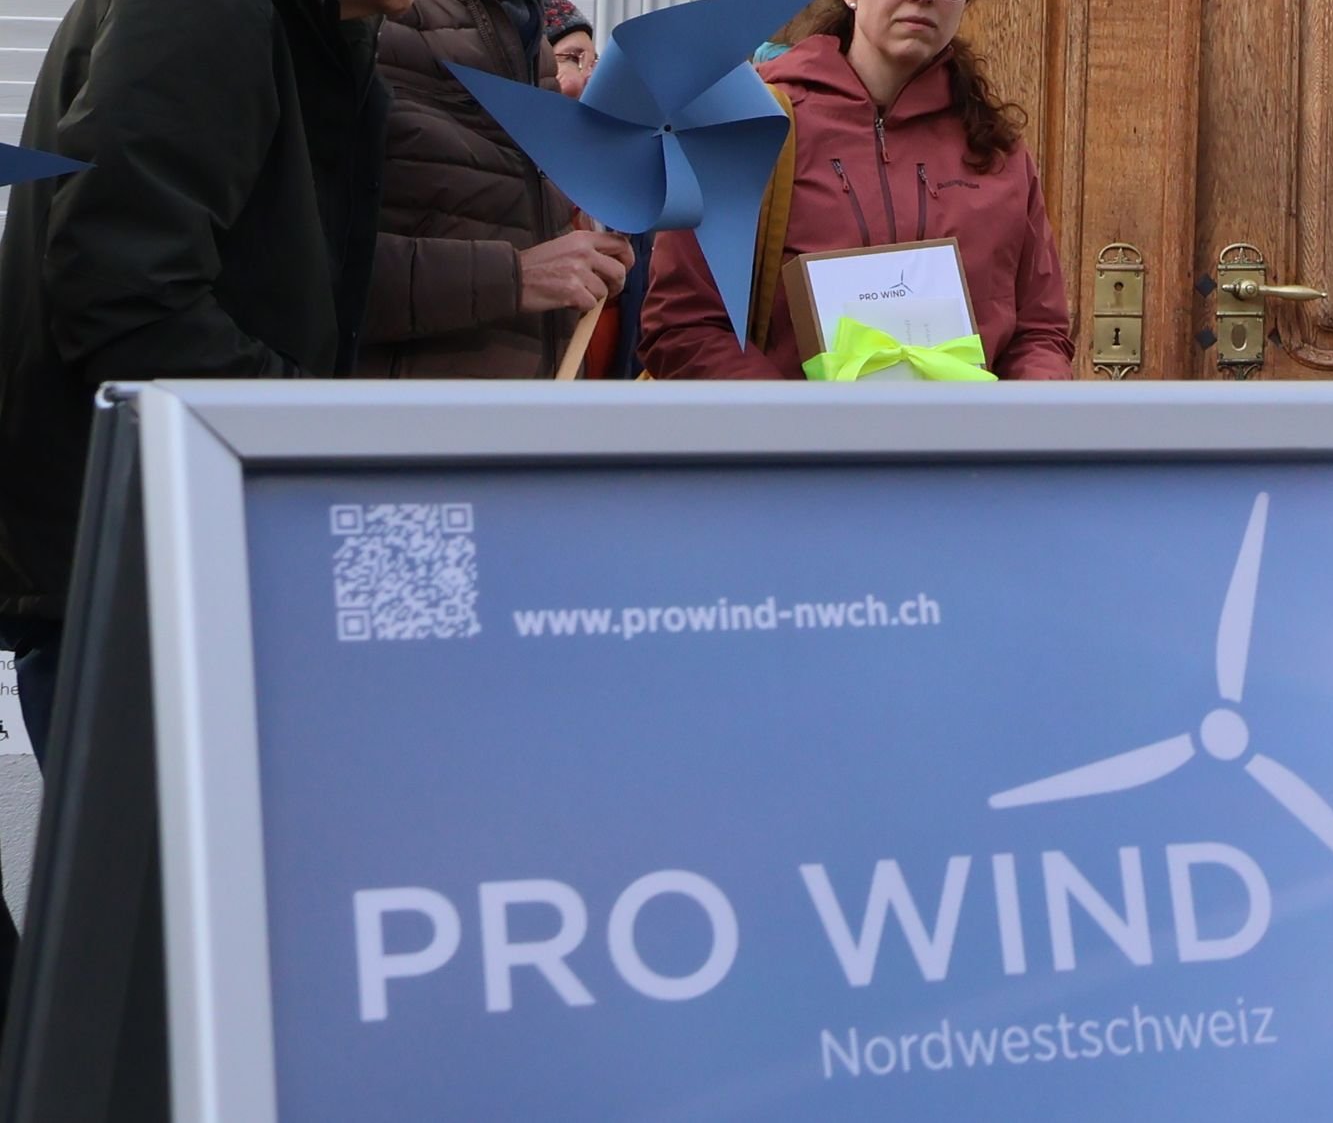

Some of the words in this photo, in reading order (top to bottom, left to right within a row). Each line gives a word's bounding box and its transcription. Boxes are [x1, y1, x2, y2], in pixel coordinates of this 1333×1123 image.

[859, 292, 878, 301] PRO
[881, 289, 906, 299] WIND
[513, 593, 941, 640] www.prowind-nwch.ch
[353, 869, 739, 1023] PRO
[799, 841, 1272, 987] WIND
[820, 997, 1278, 1079] Nordwestschweiz
